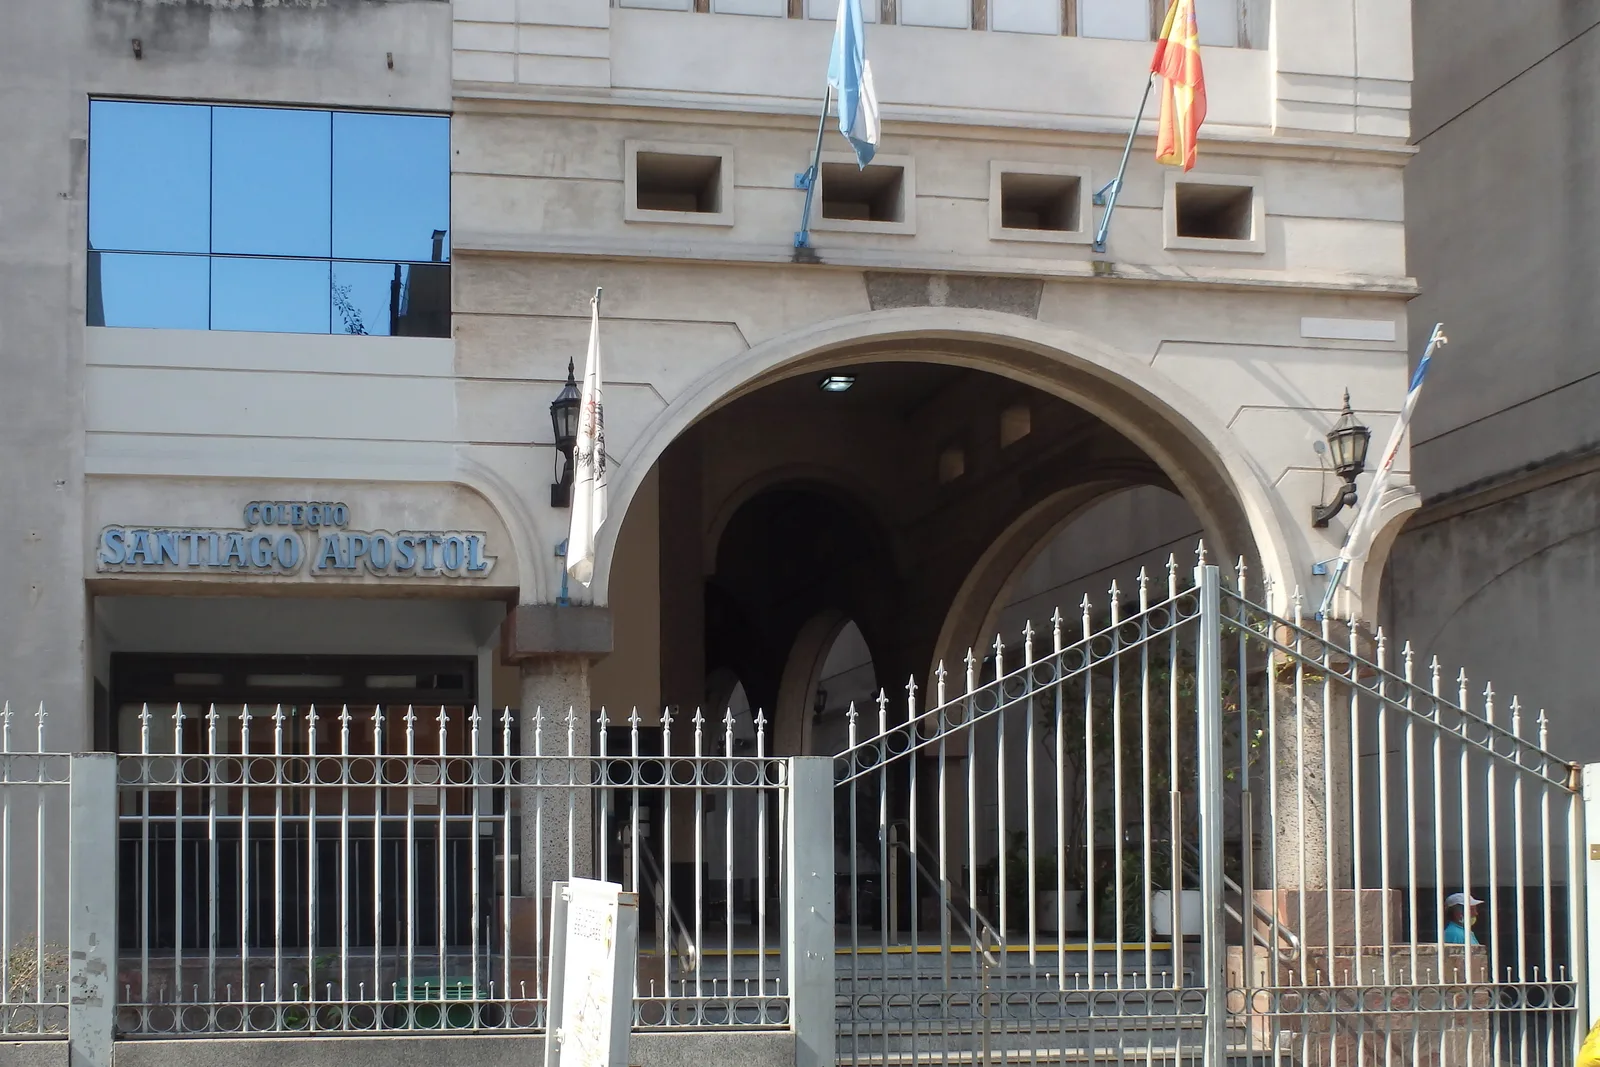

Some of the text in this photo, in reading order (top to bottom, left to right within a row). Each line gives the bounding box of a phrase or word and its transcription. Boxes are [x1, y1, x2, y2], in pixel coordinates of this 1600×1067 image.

[244, 502, 348, 527] COLEGIO
[102, 529, 488, 571] SANTIAGO APOSTOL
